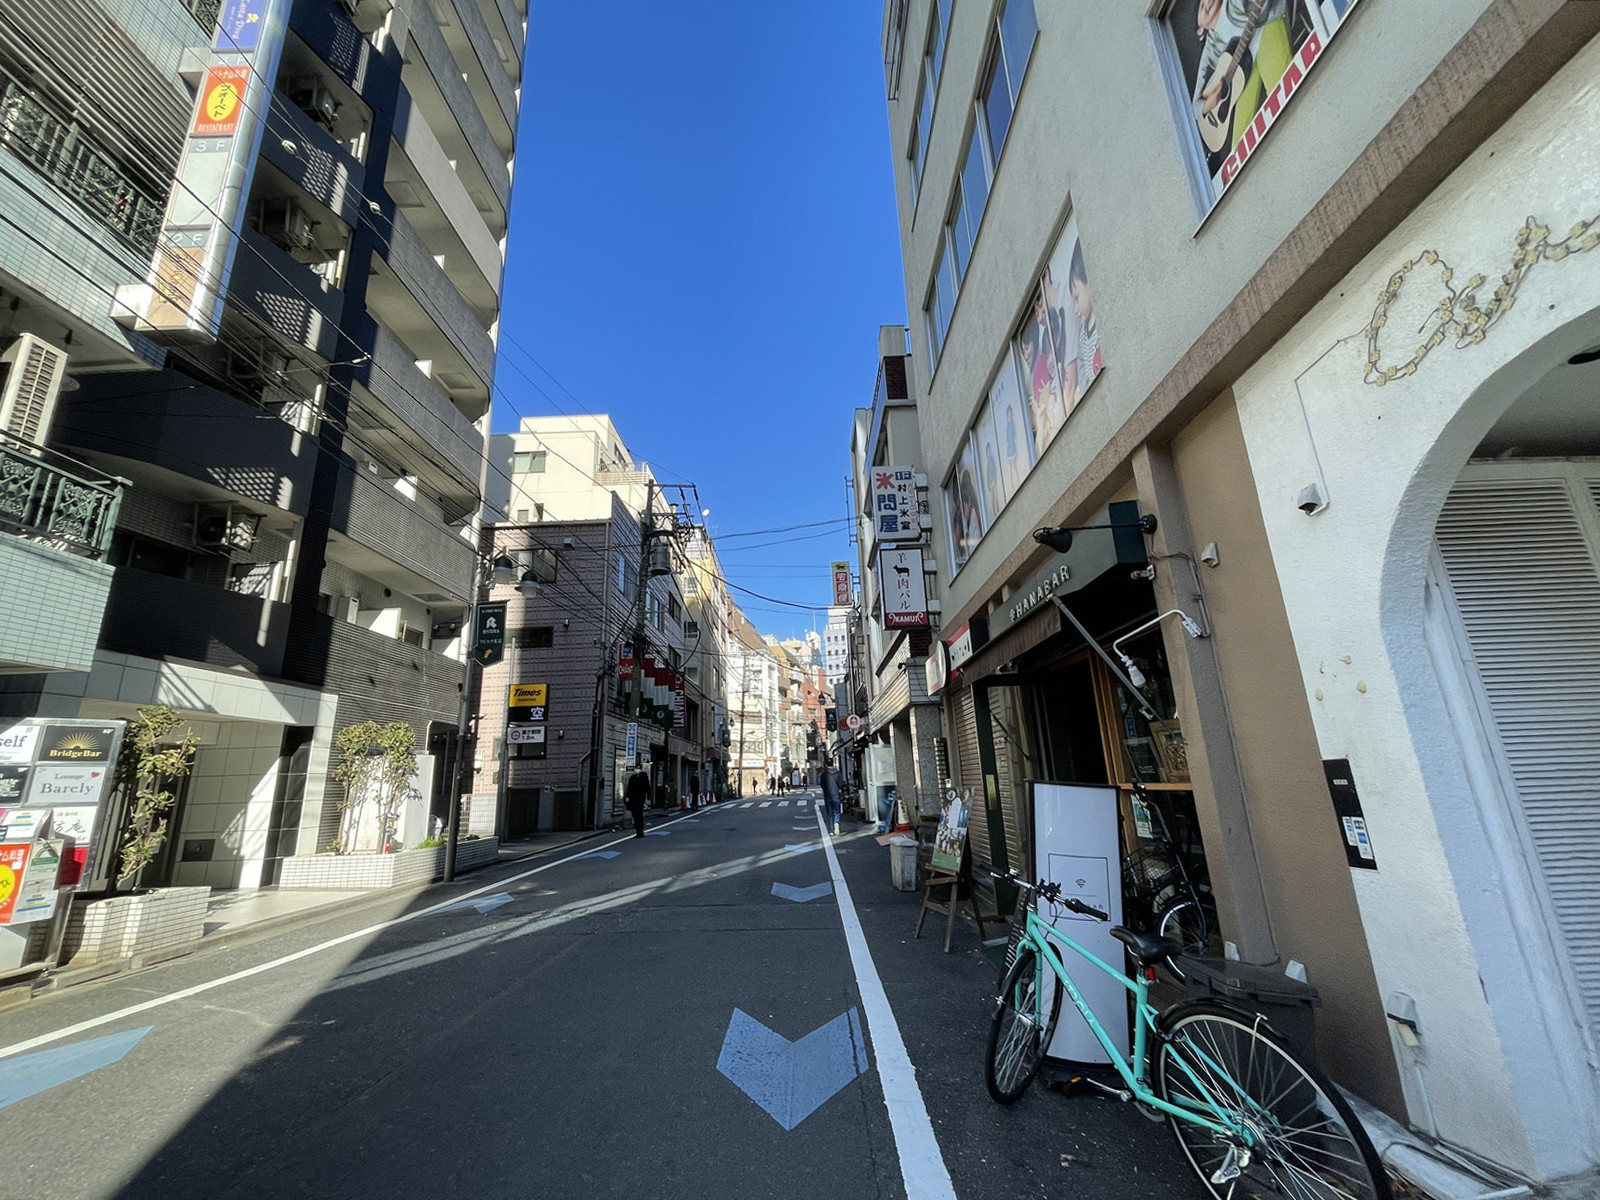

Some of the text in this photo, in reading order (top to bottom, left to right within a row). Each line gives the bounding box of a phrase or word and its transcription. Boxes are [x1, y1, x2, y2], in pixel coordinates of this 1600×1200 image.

[1015, 565, 1070, 618] HANABAR
[514, 688, 542, 697] Times
[530, 706, 544, 720] 空
[673, 689, 684, 727] CHIANTI
[40, 783, 94, 795] Barely
